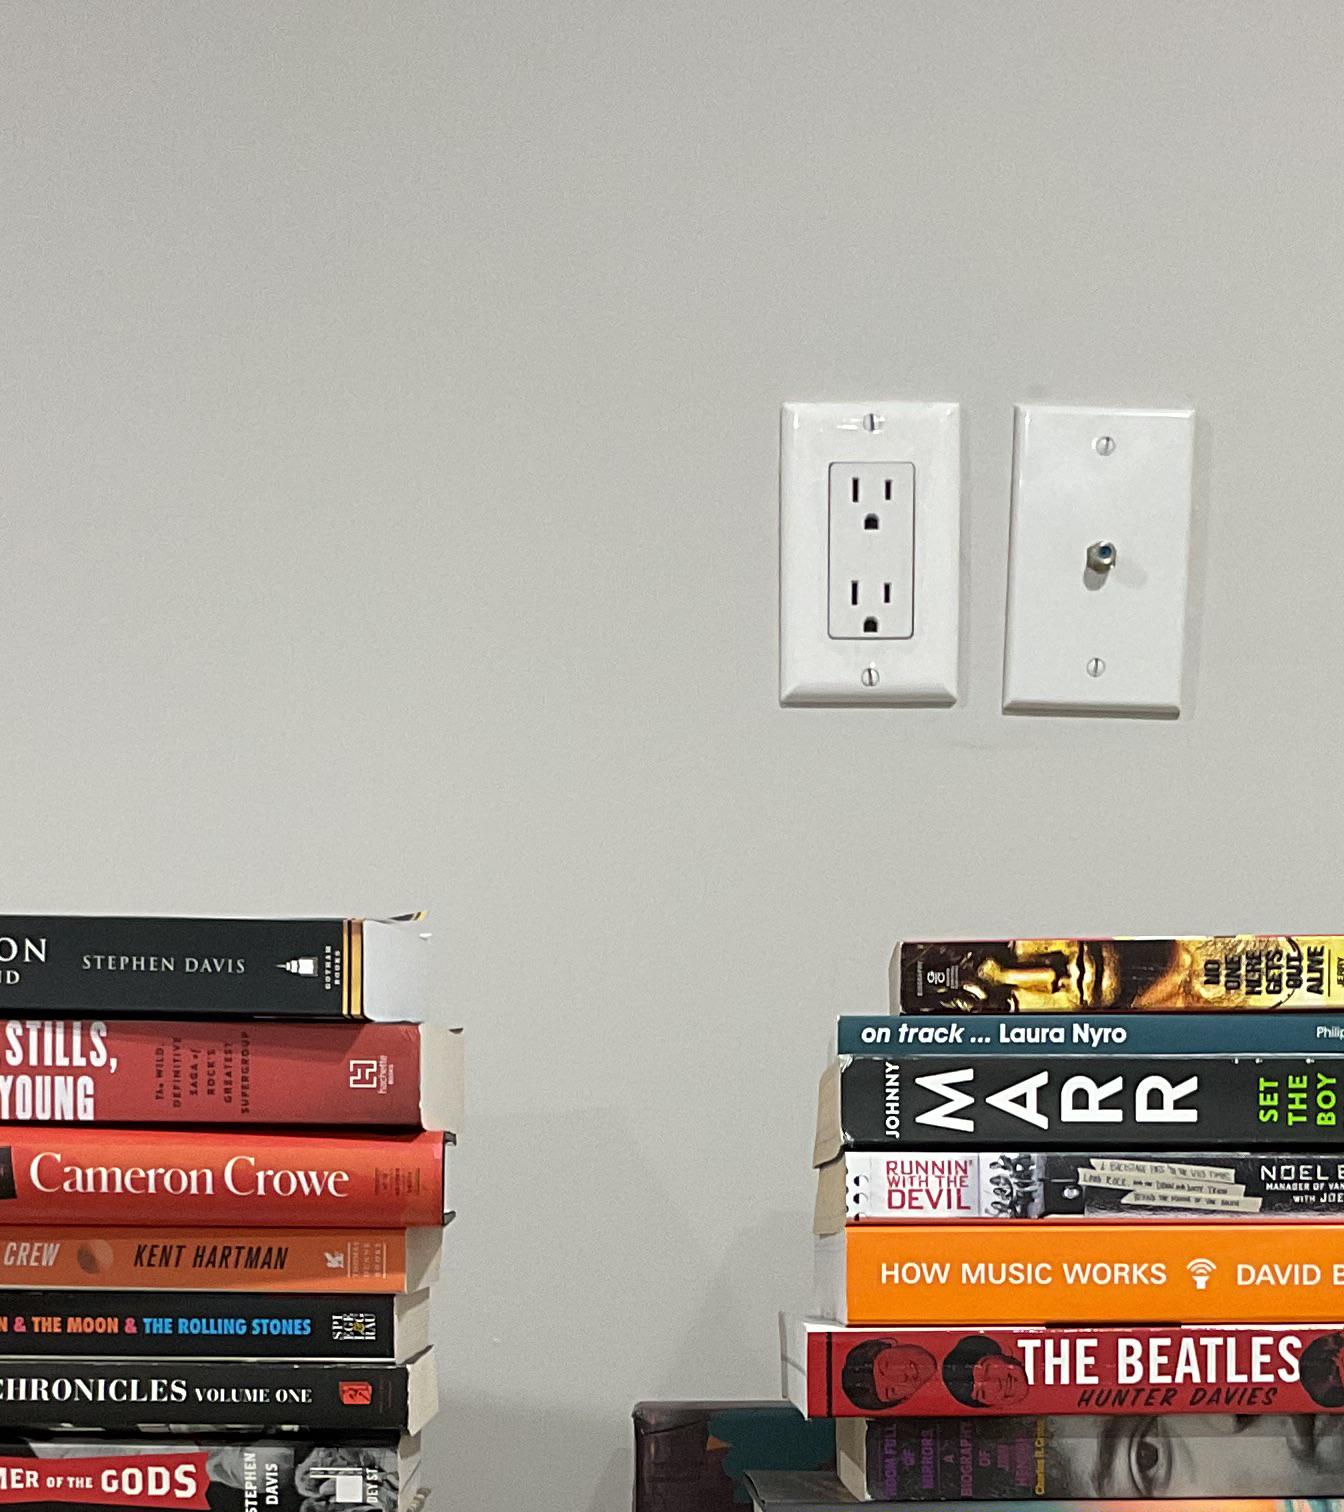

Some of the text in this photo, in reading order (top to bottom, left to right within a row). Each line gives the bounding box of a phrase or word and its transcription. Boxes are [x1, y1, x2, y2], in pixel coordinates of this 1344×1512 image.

[82, 954, 246, 974] STEPHEN DAVIS
[861, 1026, 892, 1043] on
[898, 1023, 965, 1045] track
[1000, 1023, 1065, 1044] Laura
[1072, 1025, 1127, 1046] Nyro
[30, 1150, 214, 1195] Cameron
[224, 1155, 349, 1197] Crowe
[881, 1262, 1167, 1285] HOW MUSIC WORKS
[1237, 1263, 1321, 1285] DAVID
[14, 1317, 27, 1332] &
[31, 1317, 62, 1333] THE
[67, 1317, 118, 1334] MOON
[124, 1317, 136, 1334] &
[142, 1317, 173, 1334] THE
[178, 1317, 247, 1334] ROLLING
[252, 1318, 311, 1335] STONES
[1017, 1336, 1301, 1385] THE BEATLES
[195, 1388, 270, 1403] VOLUME
[275, 1389, 312, 1403] ONE
